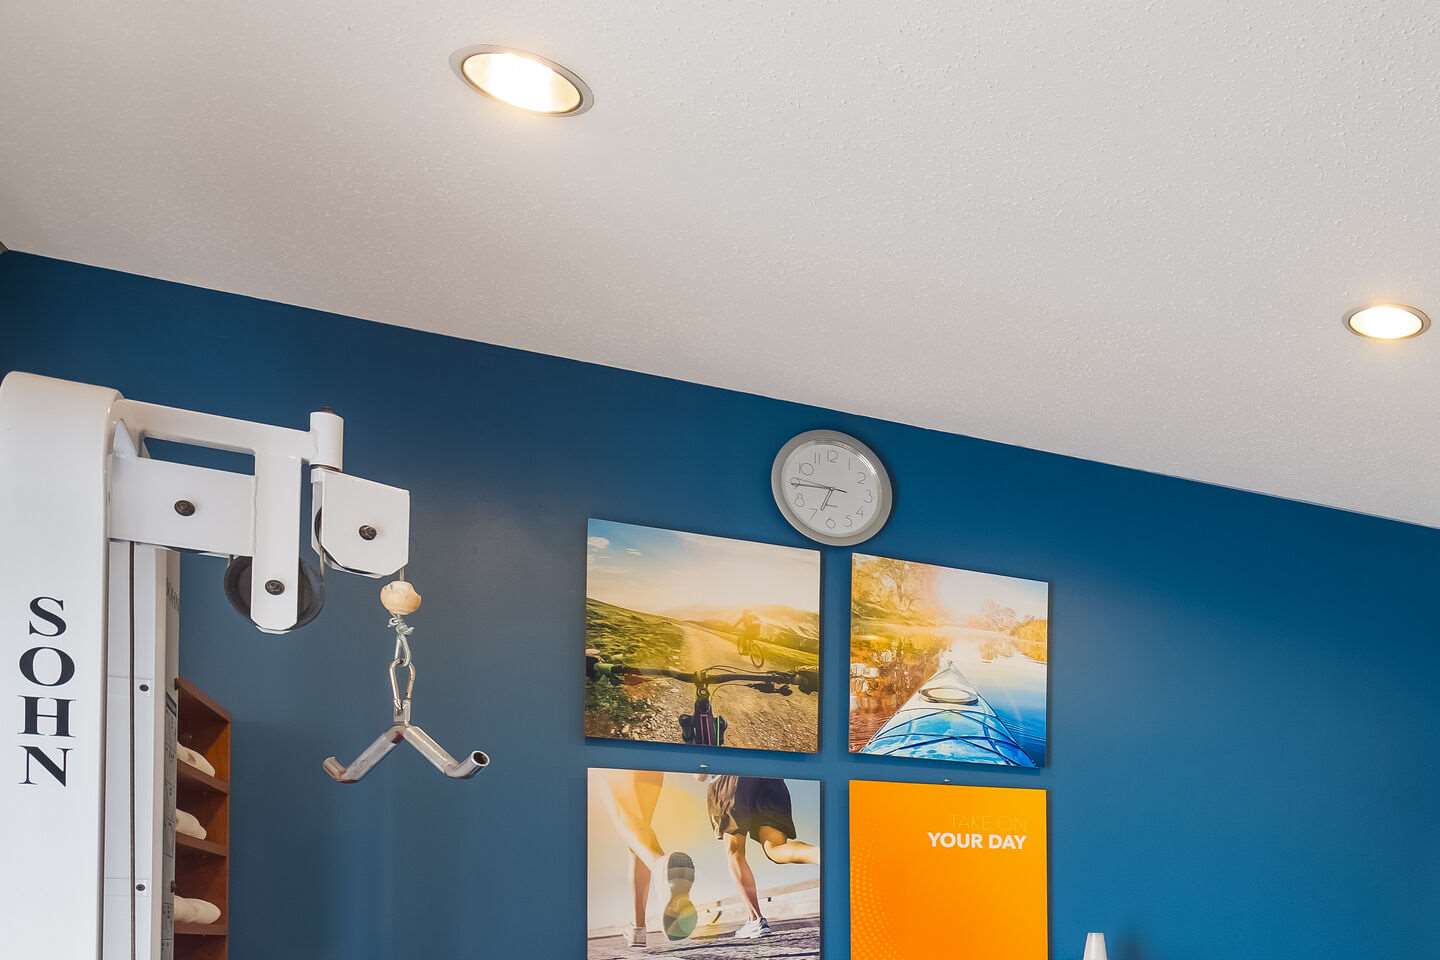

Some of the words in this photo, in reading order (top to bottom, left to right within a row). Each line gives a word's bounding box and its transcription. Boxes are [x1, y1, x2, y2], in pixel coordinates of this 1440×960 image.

[826, 450, 839, 464] 12
[798, 462, 815, 476] 10
[856, 471, 867, 485] 2
[794, 492, 805, 508] 8
[863, 488, 874, 504] 3
[806, 507, 818, 521] 7
[17, 596, 77, 787] SOHN
[927, 832, 984, 848] YOUR
[988, 834, 1027, 850] DAY
